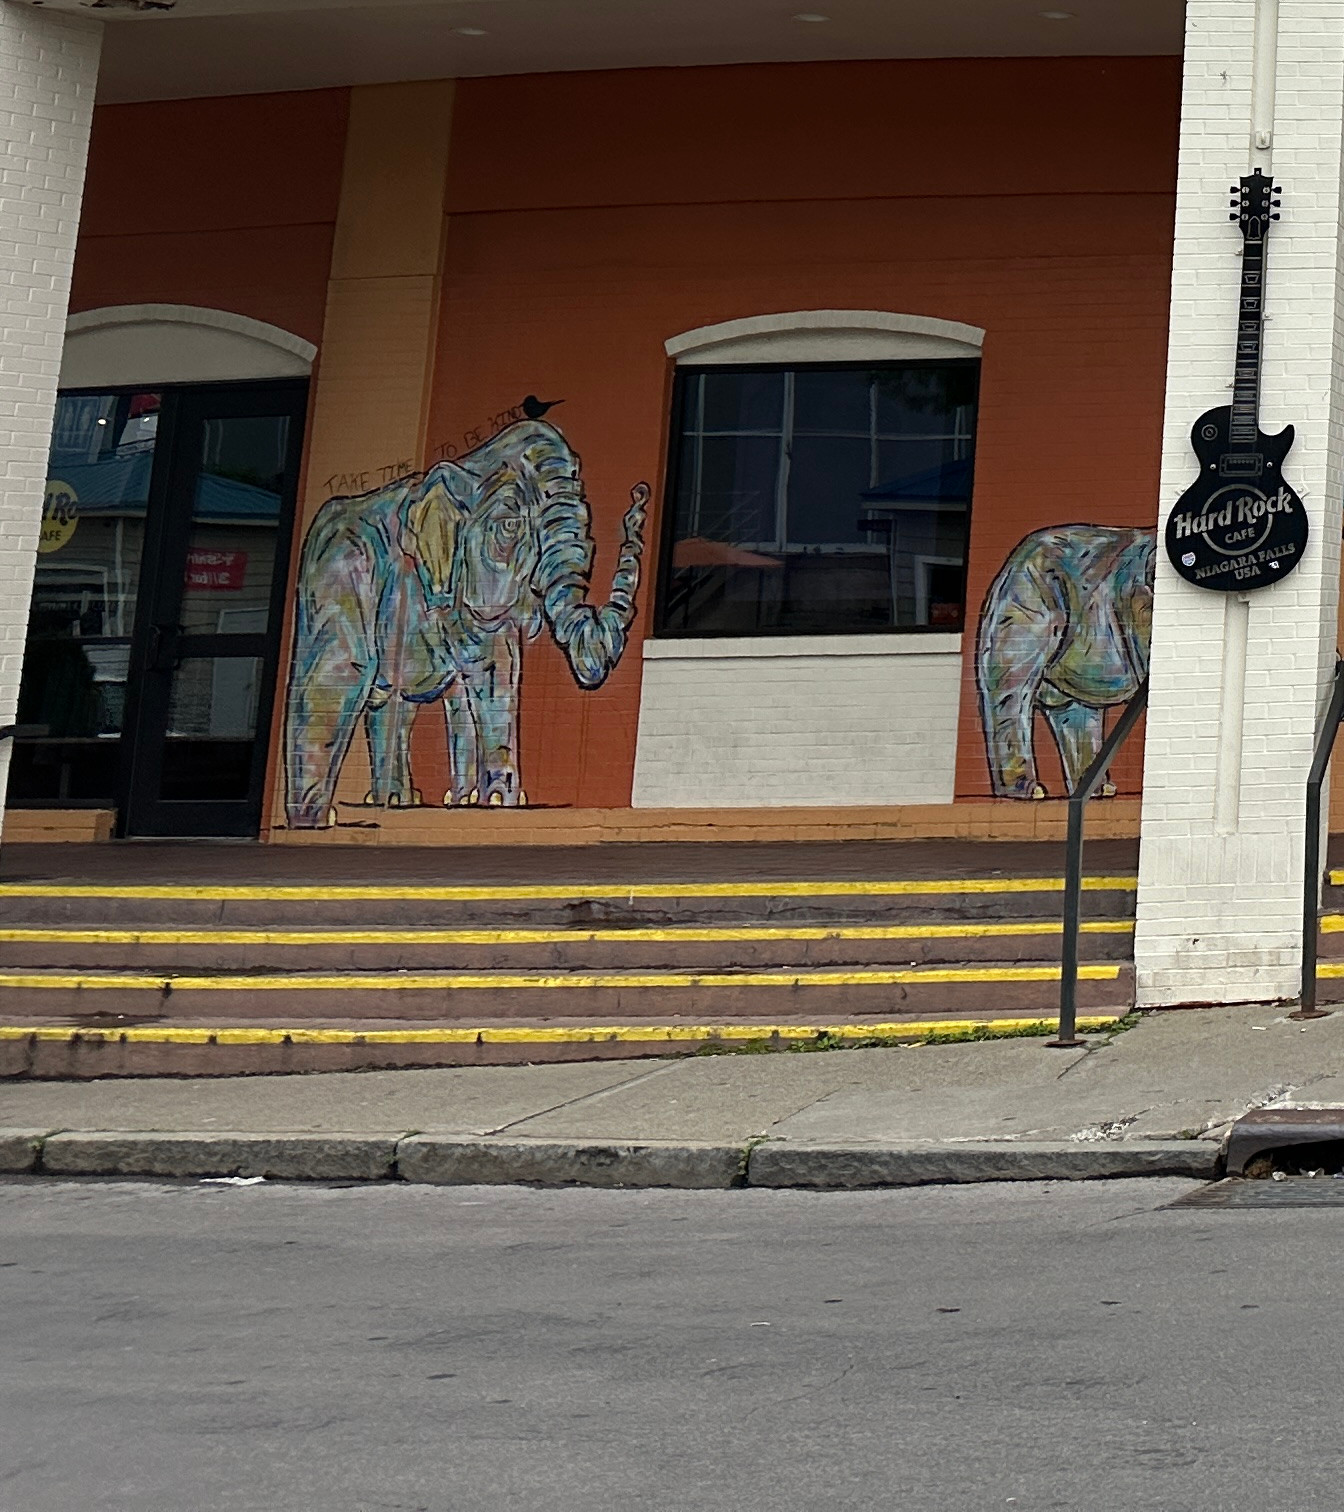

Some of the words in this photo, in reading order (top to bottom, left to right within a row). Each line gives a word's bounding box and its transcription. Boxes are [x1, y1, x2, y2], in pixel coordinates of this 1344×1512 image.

[434, 442, 457, 459] TO
[463, 426, 488, 449] BE
[323, 472, 369, 495] TAKE
[376, 457, 415, 483] TIME
[1174, 500, 1232, 539] Hard
[1236, 486, 1293, 524] Rock
[40, 530, 61, 541] AFE
[1225, 527, 1255, 544] CAFE
[1195, 555, 1257, 579] NIAGARA
[1258, 543, 1296, 563] FALLS
[1235, 566, 1261, 580] USA
